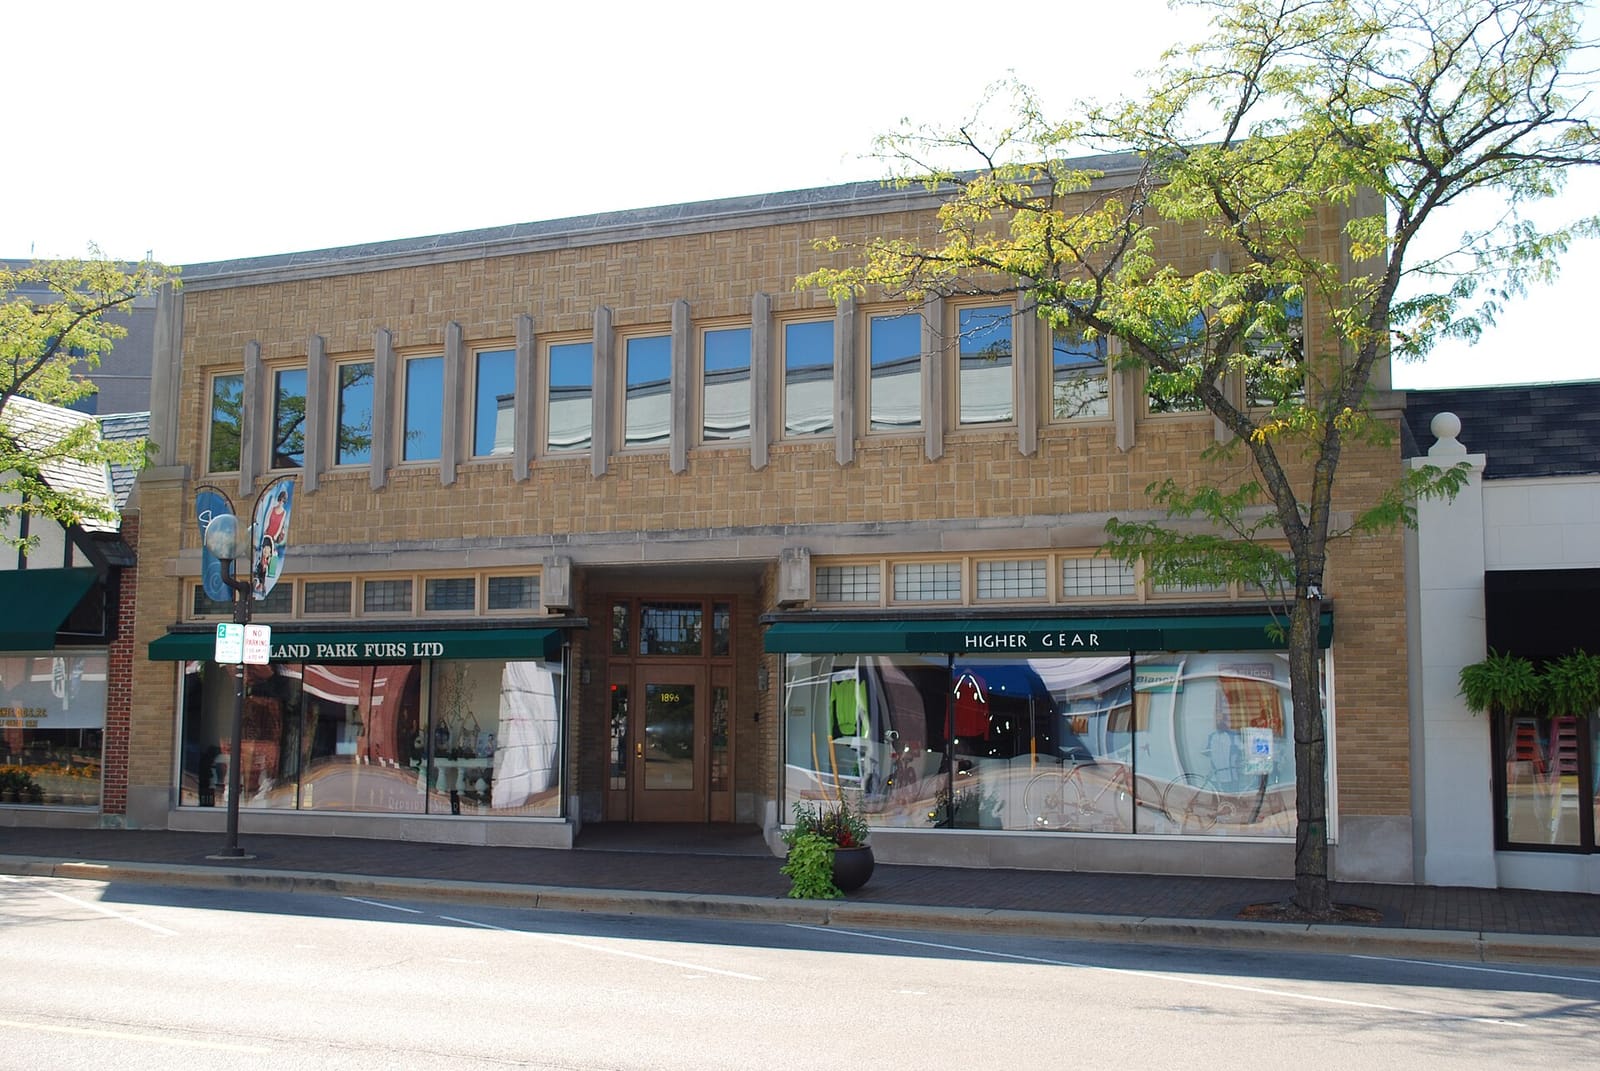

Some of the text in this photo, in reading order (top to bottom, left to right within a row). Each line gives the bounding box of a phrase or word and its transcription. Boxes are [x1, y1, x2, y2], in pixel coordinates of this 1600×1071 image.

[219, 625, 225, 637] 2
[253, 629, 263, 637] NO
[965, 633, 1100, 648] HIGHER GEAR
[317, 644, 358, 657] PARK
[364, 643, 406, 657] FURS
[412, 642, 444, 657] LTD
[661, 692, 680, 703] 1896
